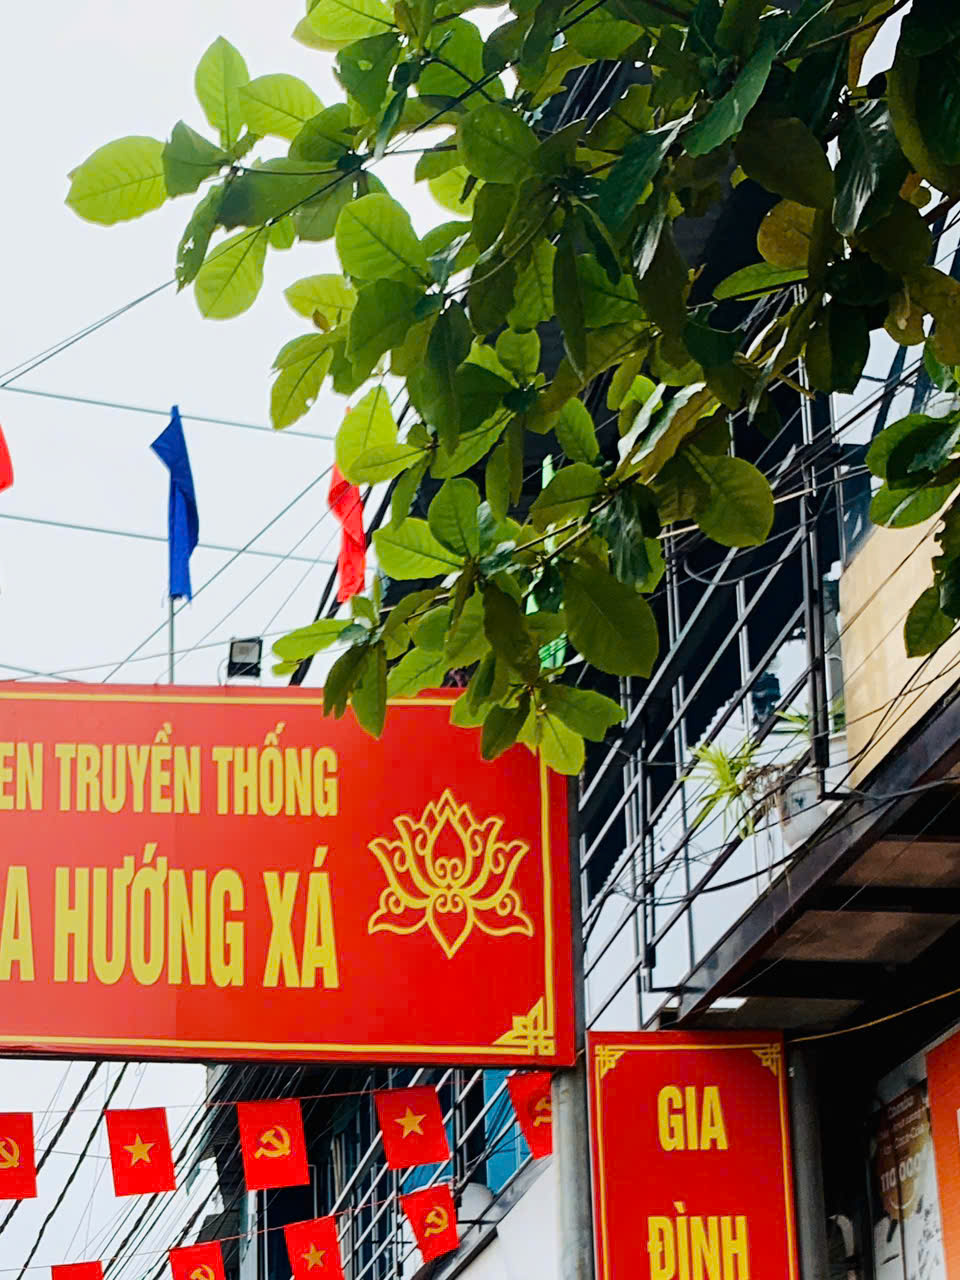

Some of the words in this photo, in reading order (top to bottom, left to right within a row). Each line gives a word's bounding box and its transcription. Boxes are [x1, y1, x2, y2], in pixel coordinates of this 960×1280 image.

[55, 722, 201, 813] TRUYỀN
[212, 721, 339, 818] THỐNG
[54, 843, 244, 988] HƯỚNG
[262, 847, 339, 988] XÁ
[657, 1085, 728, 1151] GIA
